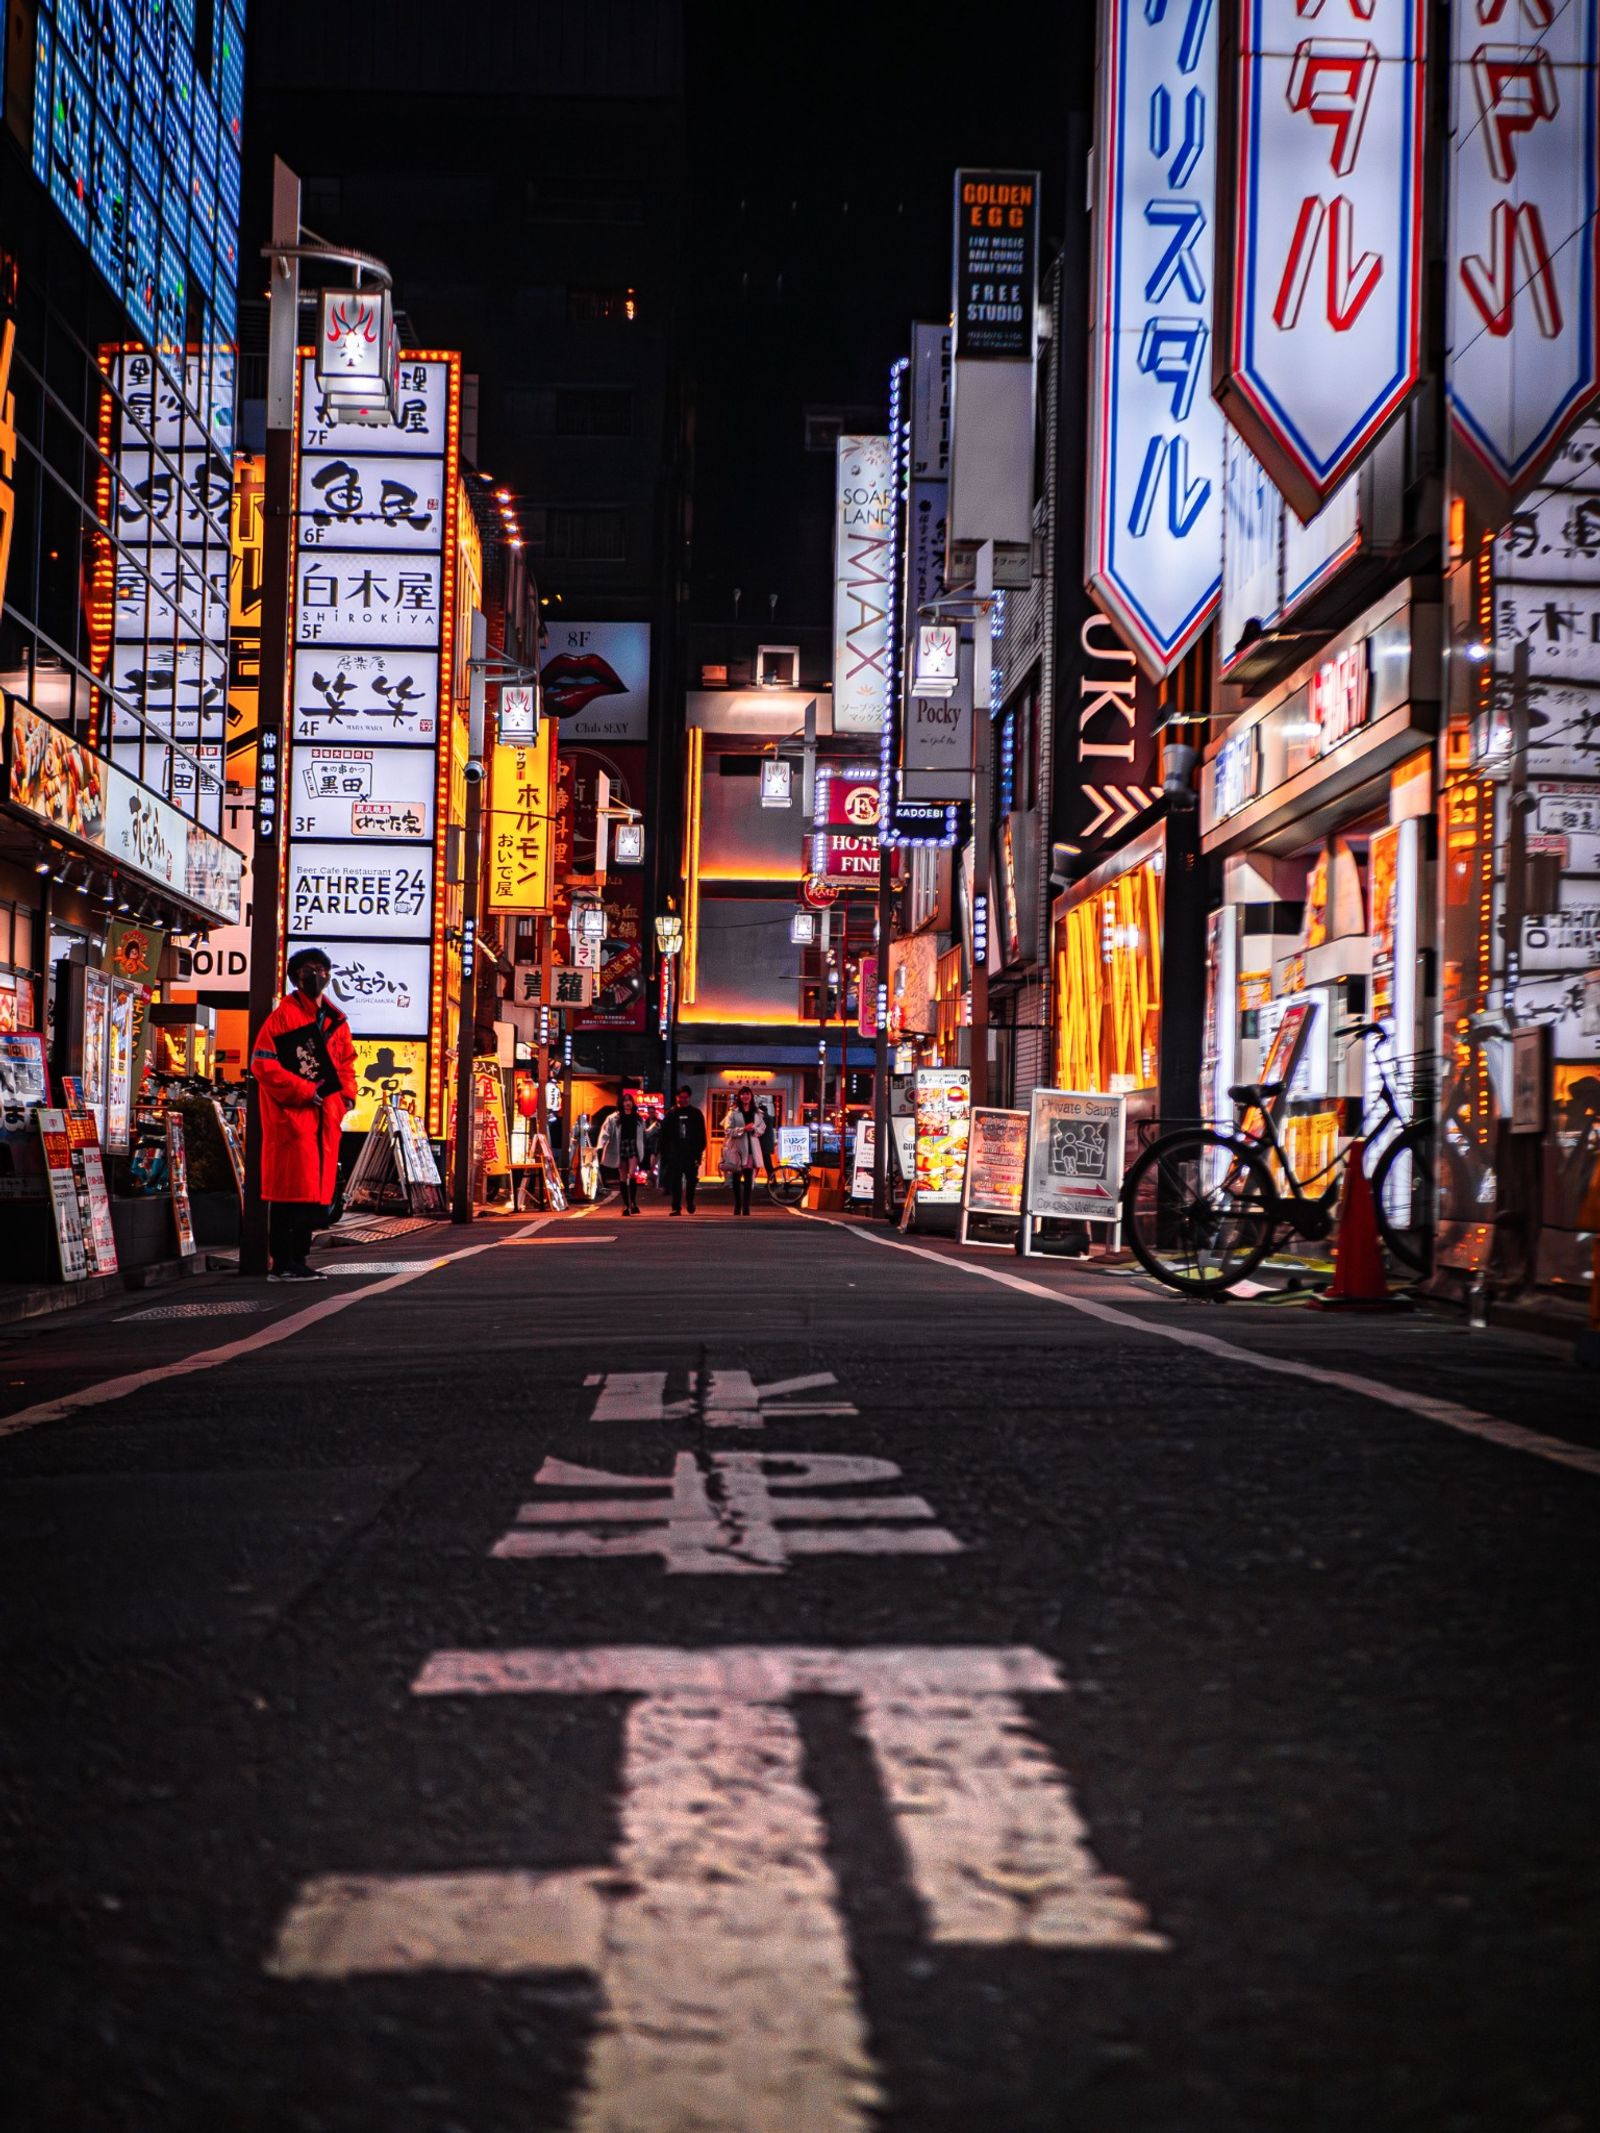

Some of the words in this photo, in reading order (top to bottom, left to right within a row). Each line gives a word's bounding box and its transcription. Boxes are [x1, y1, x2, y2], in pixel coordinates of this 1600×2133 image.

[1271, 0, 1383, 332] タル
[962, 183, 1033, 207] GOLDEN
[970, 206, 1024, 228] EGG
[970, 284, 1020, 302] FREE
[967, 304, 1023, 322] STUDIO
[307, 430, 328, 446] 7F
[311, 459, 433, 531] 魚民
[303, 528, 326, 544] 6F
[303, 562, 438, 610] 白木屋
[845, 532, 893, 681] MAX
[301, 625, 323, 639] 5F
[567, 631, 591, 648] 8F
[299, 671, 426, 727] 笑笑
[916, 699, 962, 732] Pocky
[299, 721, 320, 736] 4F
[260, 732, 277, 836] 仲見世通り
[320, 775, 364, 795] 黒田
[896, 808, 944, 819] KADOEBI
[295, 817, 316, 832] 3F
[516, 783, 541, 886] ホルモン
[296, 866, 317, 874] Beer
[320, 867, 340, 875] Cafe
[342, 867, 392, 876] Restaurant
[495, 834, 515, 897] おいで屋
[295, 896, 390, 915] PARLOR
[292, 916, 314, 931] 2F
[1041, 1100, 1082, 1115] Private
[1084, 1101, 1120, 1118] Sauna
